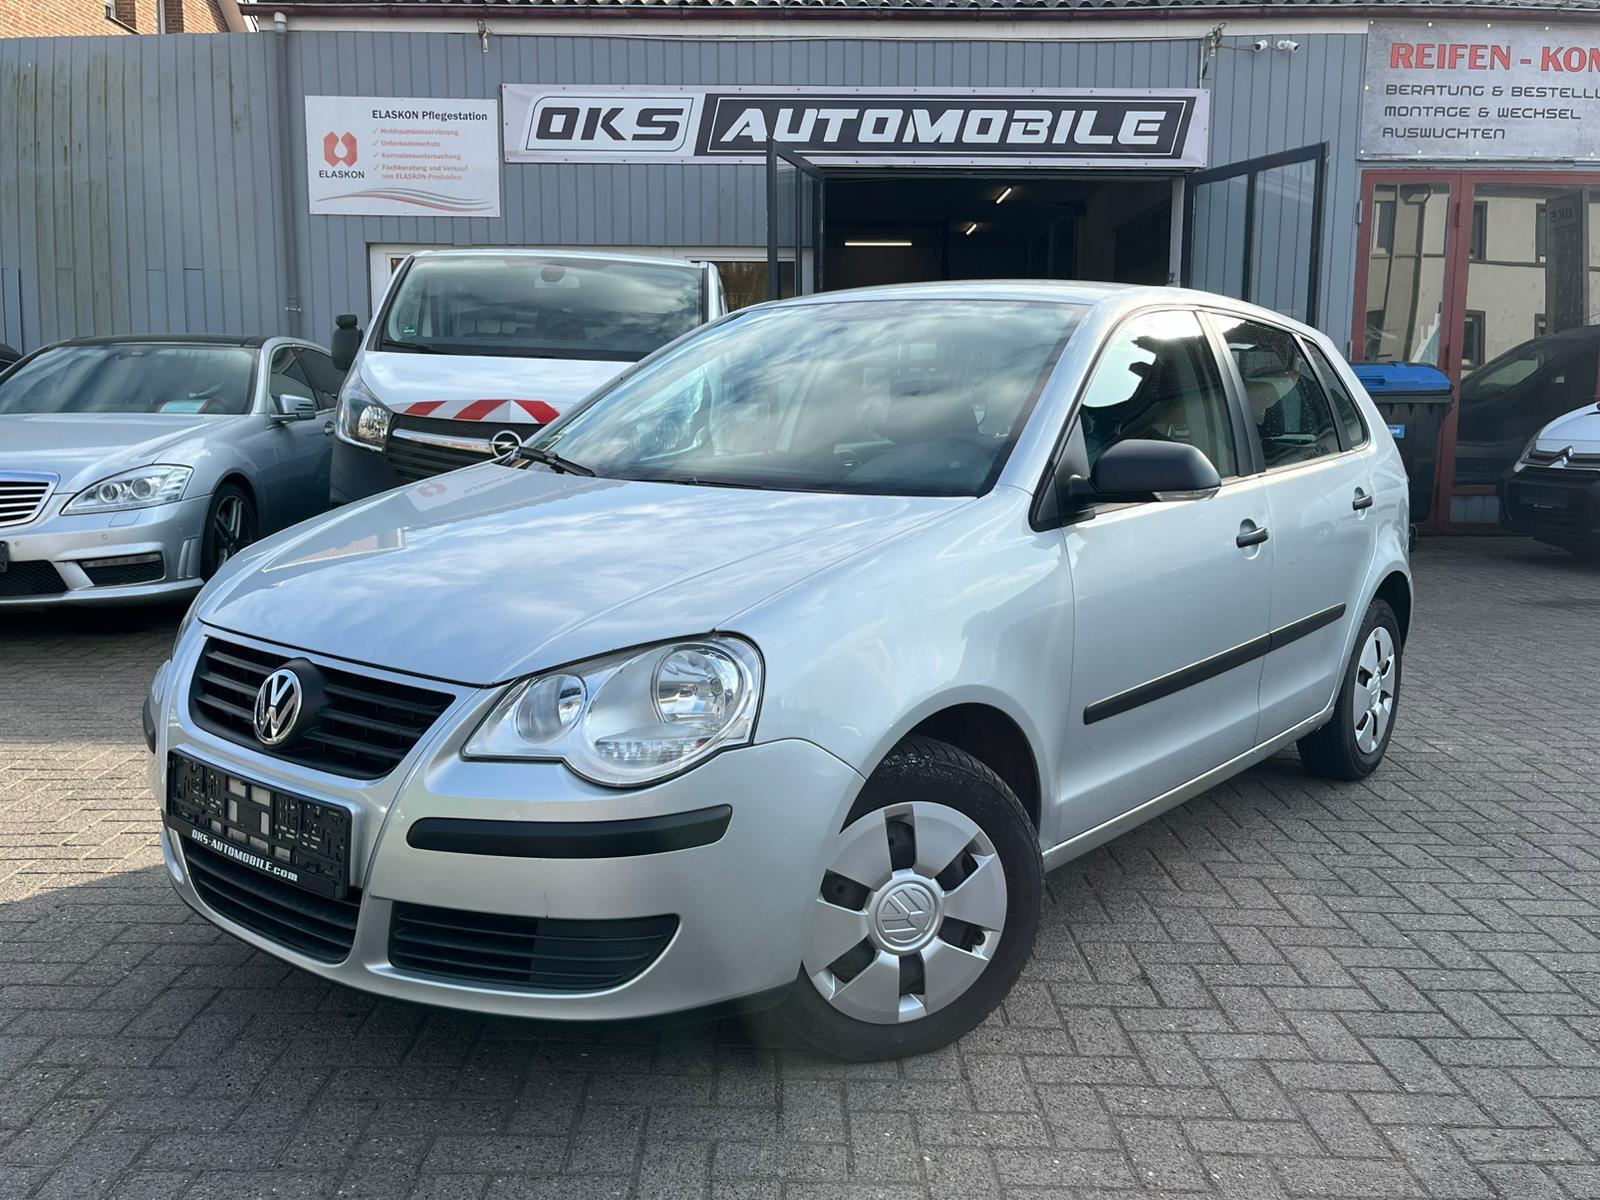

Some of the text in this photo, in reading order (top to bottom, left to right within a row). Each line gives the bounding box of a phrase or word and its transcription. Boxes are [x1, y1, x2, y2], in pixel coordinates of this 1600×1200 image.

[1390, 43, 1511, 70] REIFEN
[1386, 84, 1485, 96] BERATUNG
[1492, 86, 1504, 96] &
[372, 110, 487, 122] ELASKON Pflegestation
[1384, 106, 1582, 120] MONTAGE & WECHSEL
[536, 107, 1166, 145] OKS AUTOMOBILE
[1382, 127, 1505, 139] AUSWUCHTEN
[319, 170, 364, 179] ELASKON
